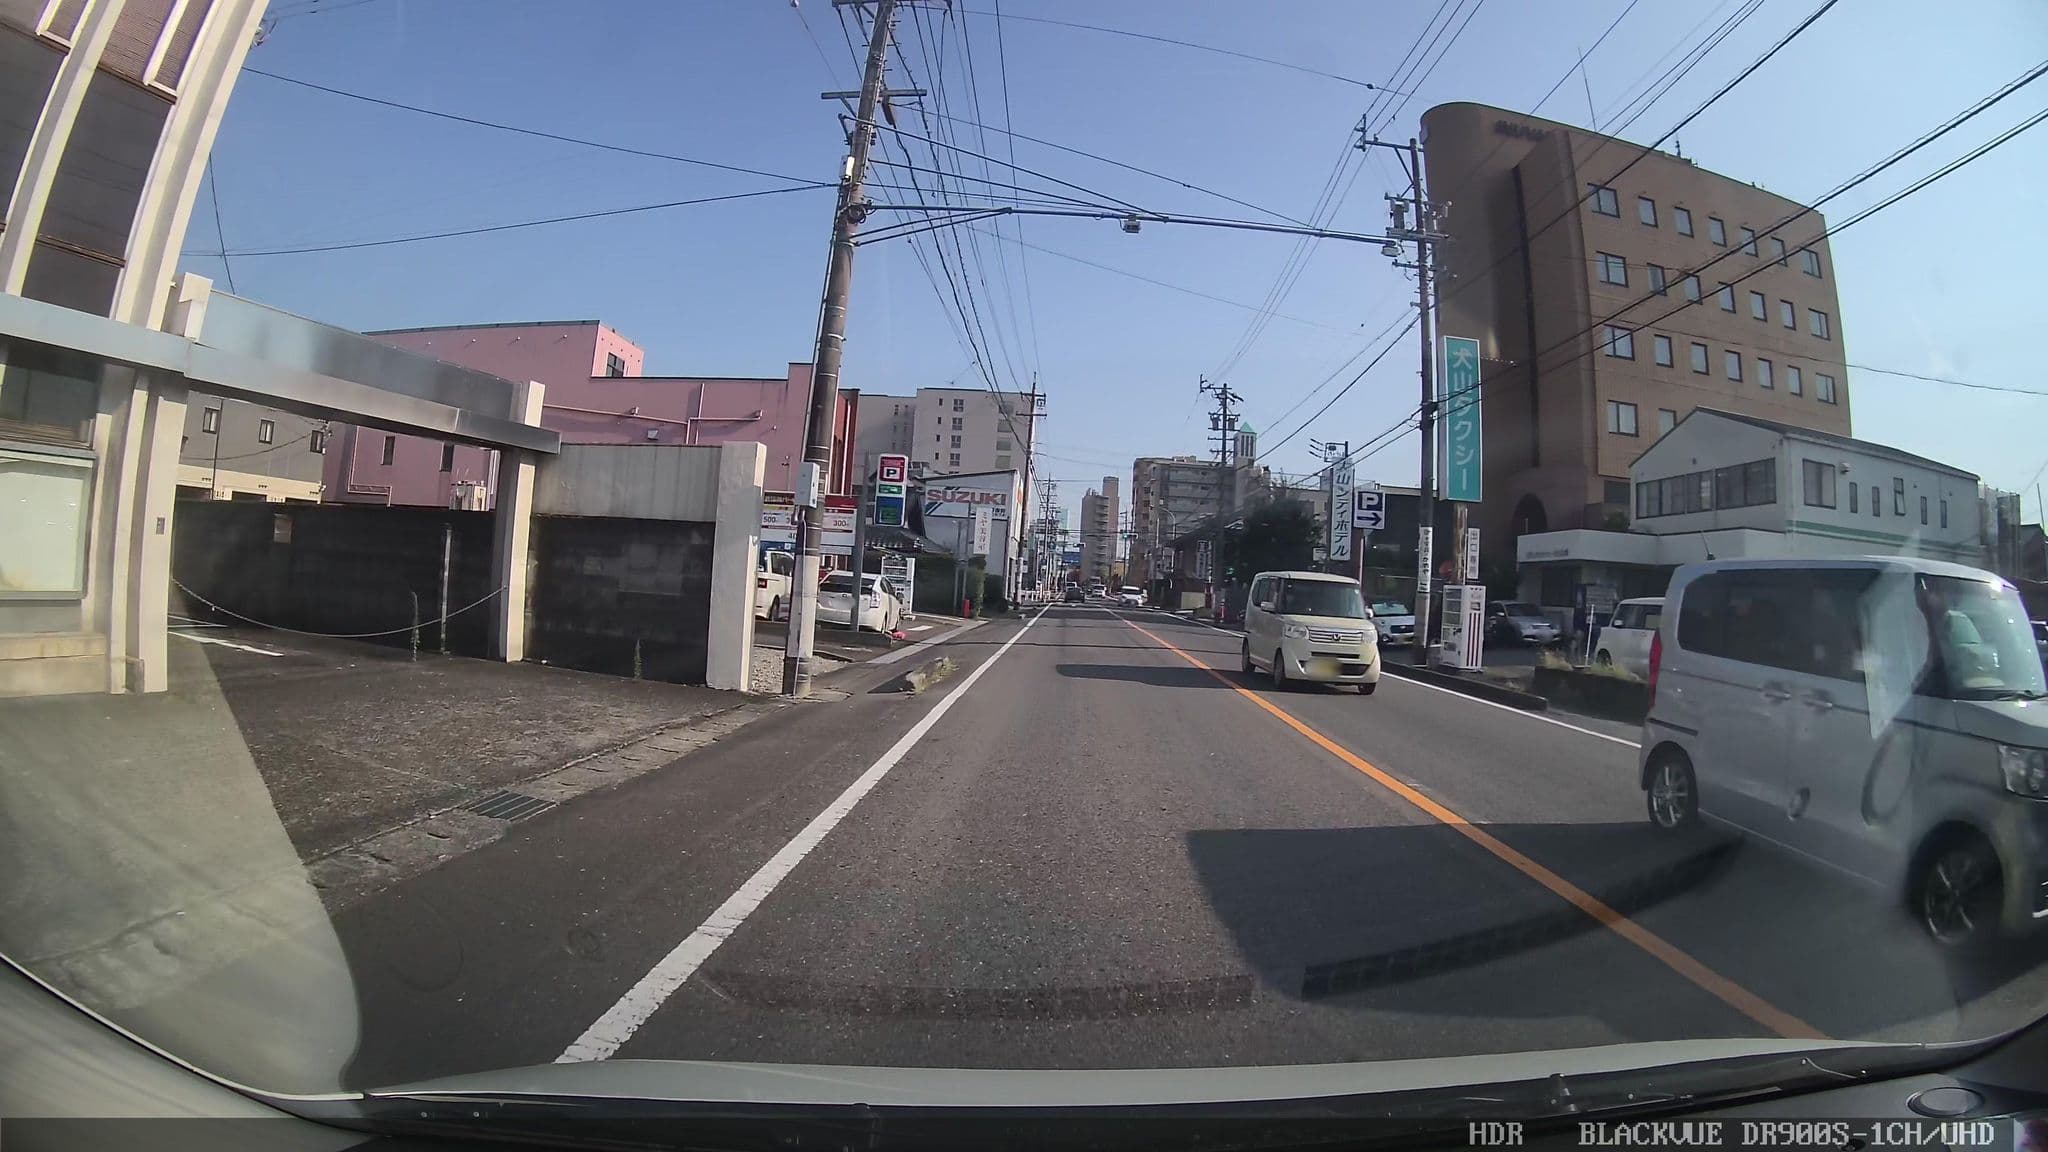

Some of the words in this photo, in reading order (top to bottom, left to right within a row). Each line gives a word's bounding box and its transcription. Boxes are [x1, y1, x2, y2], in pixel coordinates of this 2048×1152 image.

[1452, 347, 1475, 490] 犬山タクシー
[886, 468, 897, 478] P
[926, 488, 1007, 505] SUZUKI
[1362, 493, 1379, 510] P
